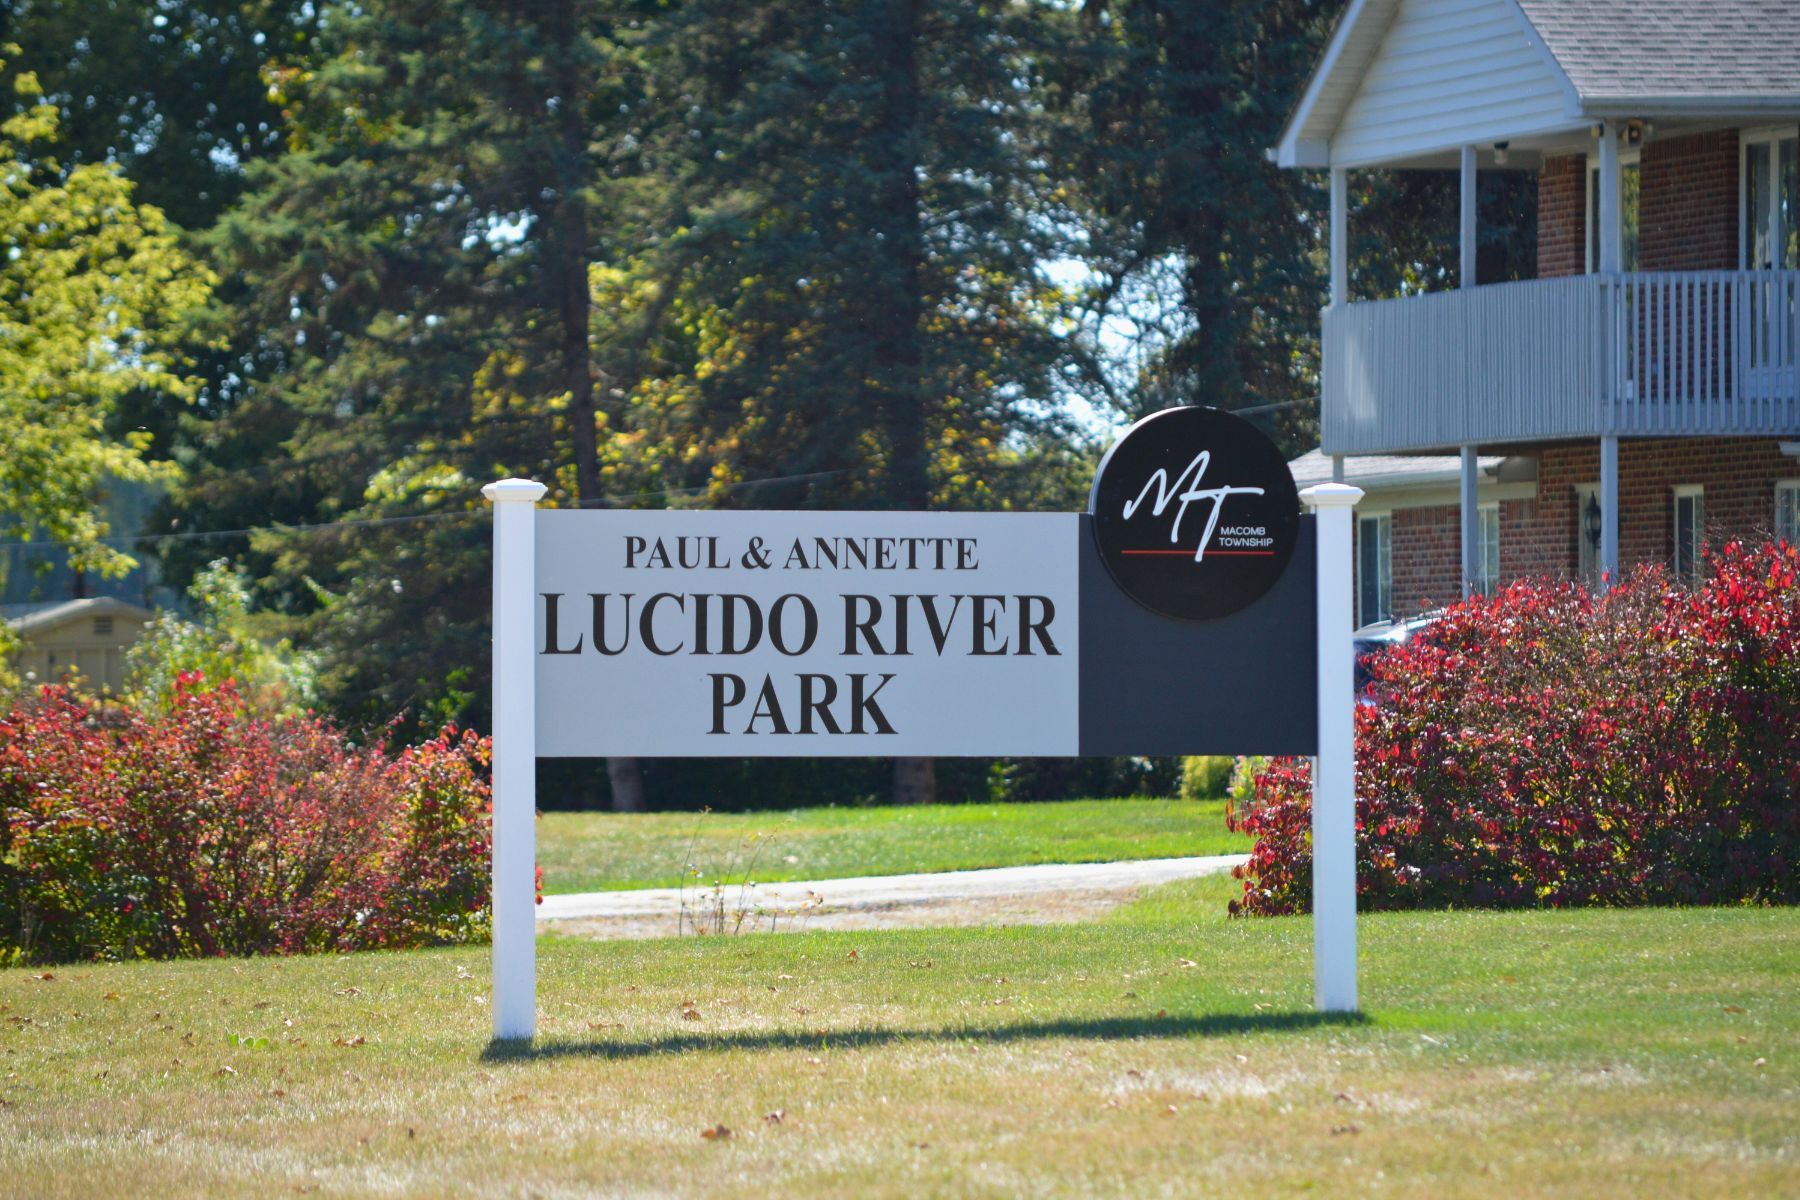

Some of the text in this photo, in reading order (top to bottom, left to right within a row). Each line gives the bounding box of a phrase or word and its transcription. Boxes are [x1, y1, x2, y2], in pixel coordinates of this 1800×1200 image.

[1219, 537, 1274, 547] TOWNSHIP
[1220, 526, 1266, 536] MACOMB
[625, 535, 979, 570] PAUL & ANNETTE
[538, 592, 1063, 657] LUCIDO RIVER
[706, 672, 899, 735] PARK
